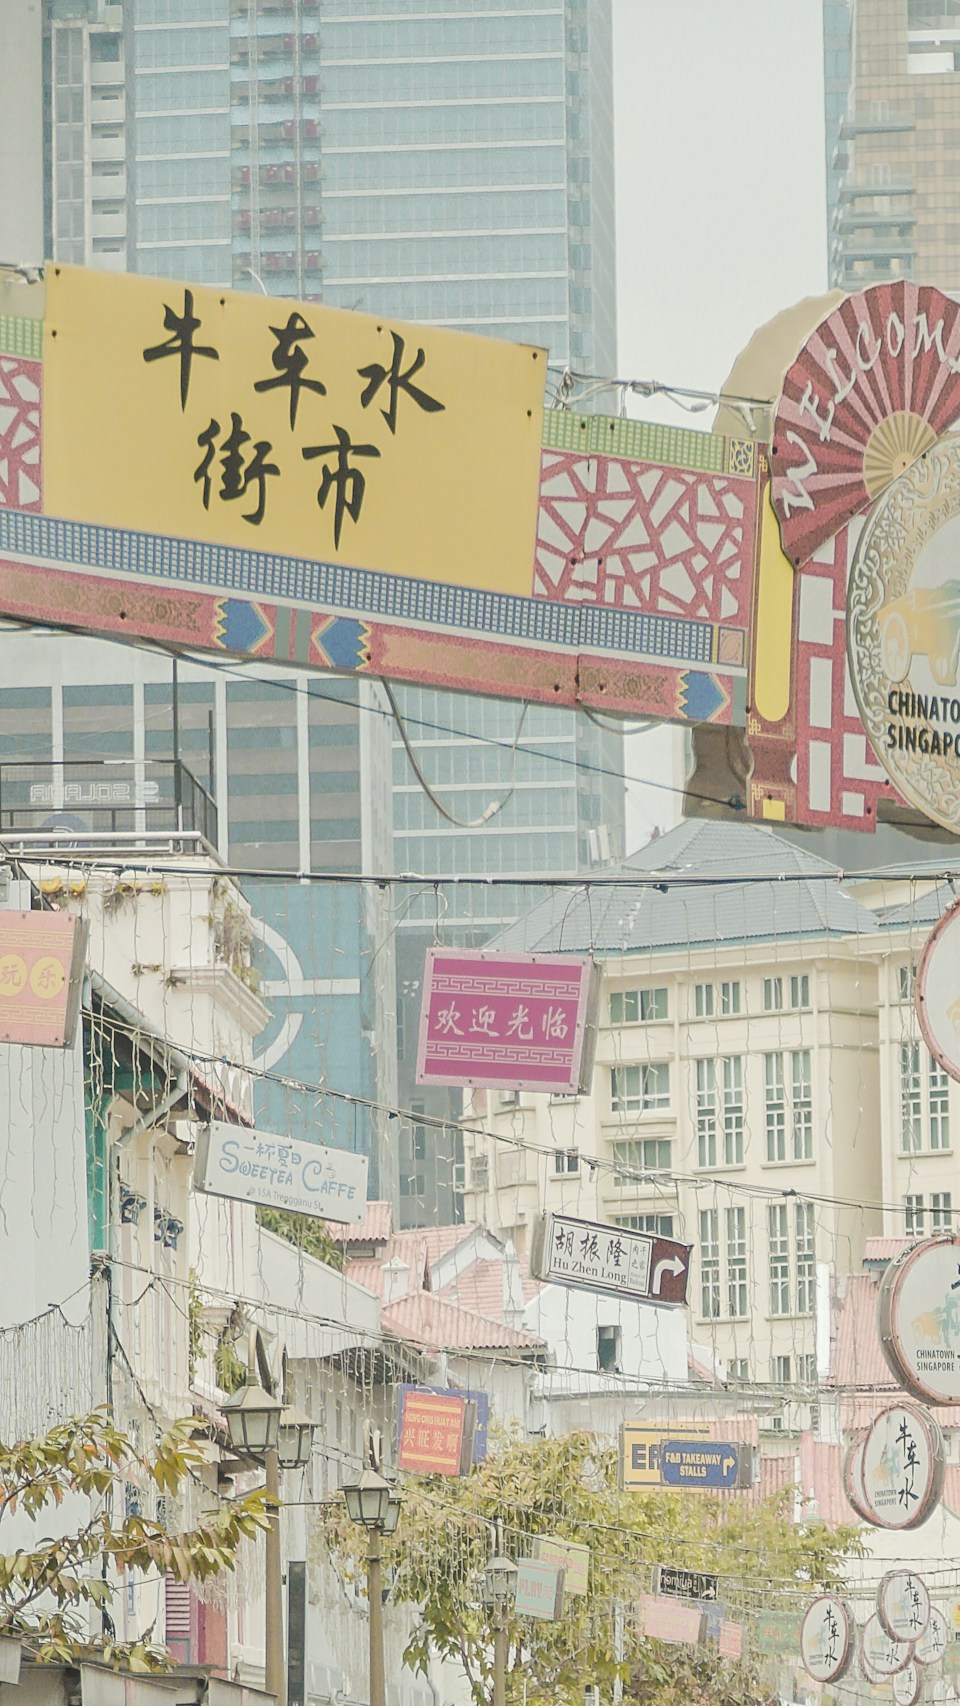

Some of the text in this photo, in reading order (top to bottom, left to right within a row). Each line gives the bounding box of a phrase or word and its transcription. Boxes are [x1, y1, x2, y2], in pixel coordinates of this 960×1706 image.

[143, 289, 446, 435] 牛车水
[194, 412, 381, 551] 街市
[434, 1001, 568, 1040] 欢迎光临
[273, 1191, 313, 1210] Trengganu
[553, 1256, 569, 1270] Hu
[571, 1260, 598, 1278] Zhen
[601, 1267, 627, 1285] Long
[916, 1349, 955, 1359] CHINATOWN
[916, 1361, 955, 1371] SINGAPORE
[665, 1452, 721, 1465] F&B TAKEAWAY
[680, 1465, 707, 1477] STALLS
